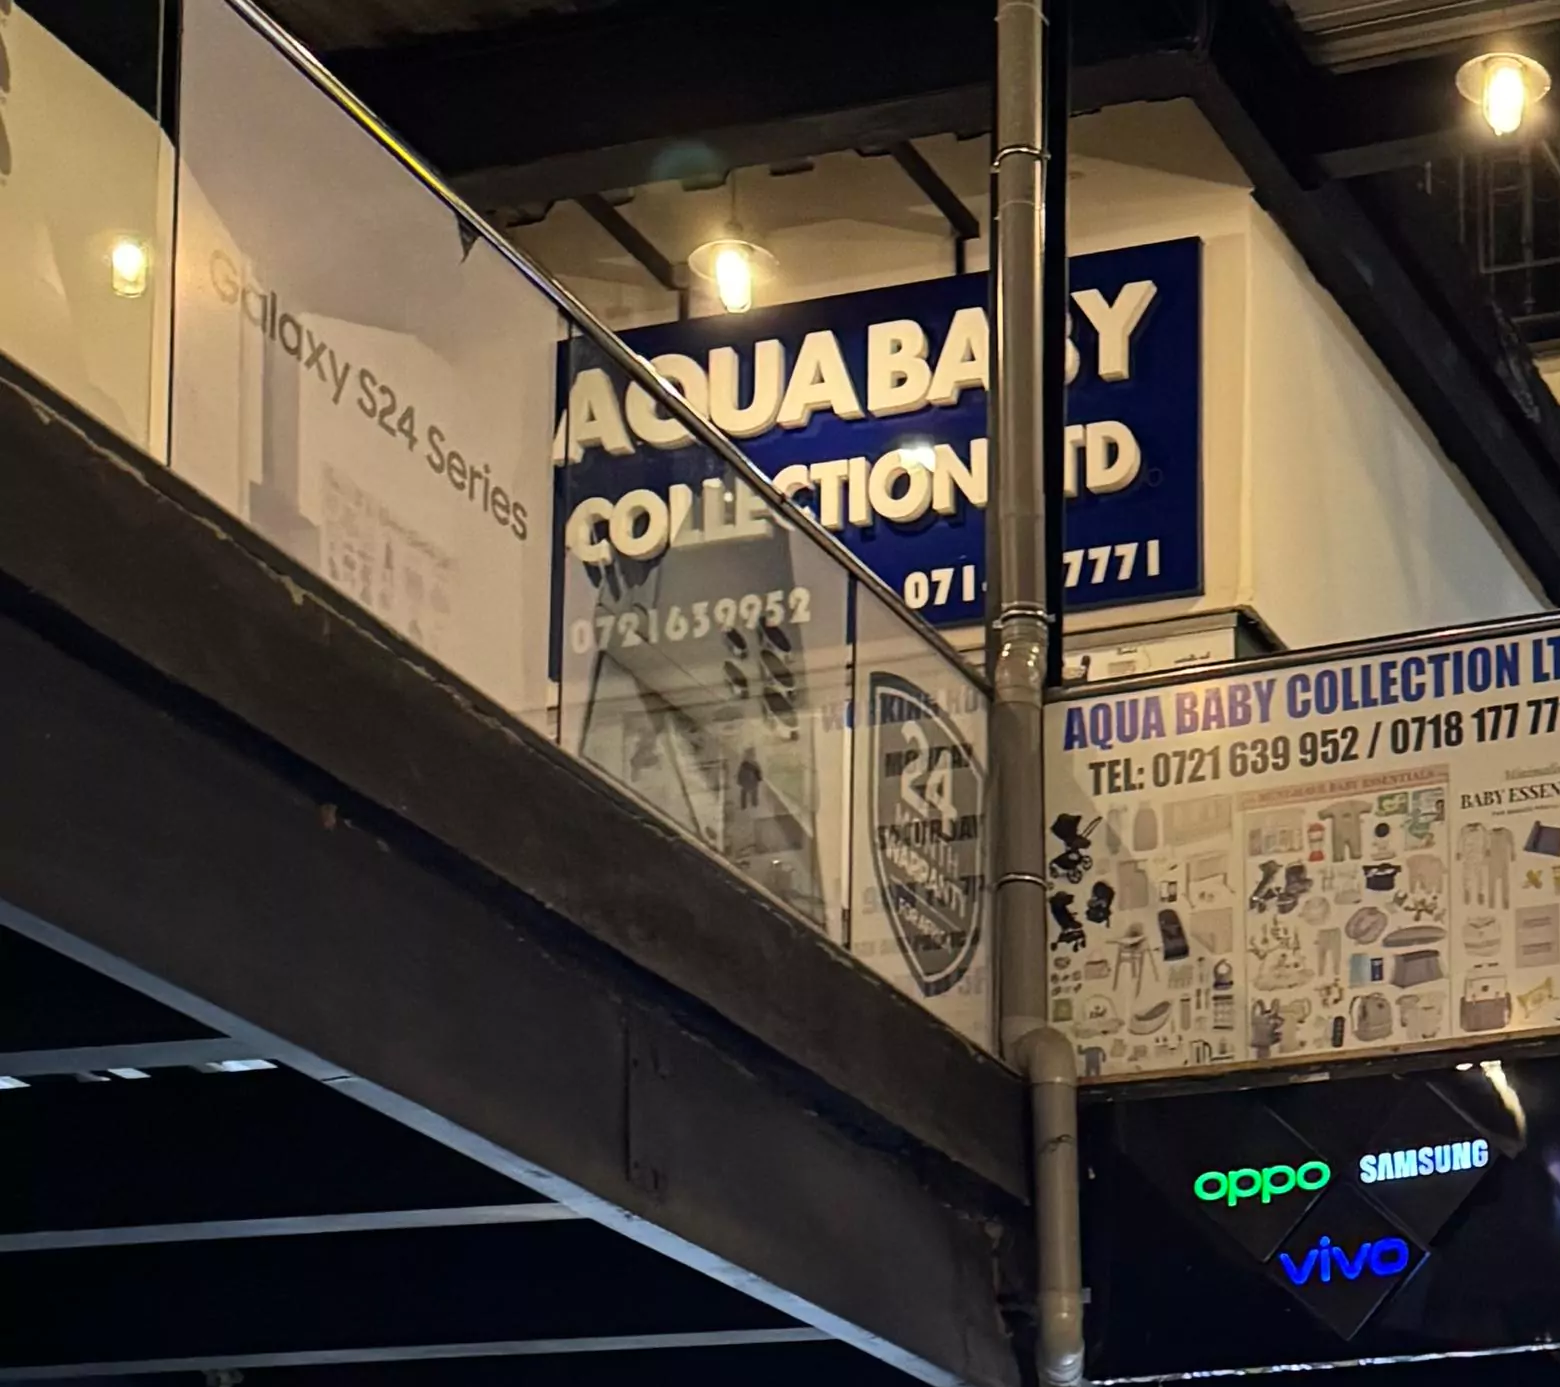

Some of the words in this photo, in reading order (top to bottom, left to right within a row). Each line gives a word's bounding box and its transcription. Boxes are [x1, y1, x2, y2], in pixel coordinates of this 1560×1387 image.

[209, 252, 351, 406] Galaxy
[357, 368, 418, 452] S24
[426, 425, 528, 541] Series
[552, 328, 864, 467] AQUA
[866, 279, 1157, 419] BAY
[1063, 420, 1141, 497] TD
[572, 586, 811, 656] 0721639952
[1063, 692, 1179, 751] AQUA
[1175, 676, 1278, 735] BABY
[1286, 643, 1521, 719] COLLECTION
[901, 722, 959, 837] 24
[1088, 758, 1145, 797] TEL:
[1151, 745, 1224, 789] 0721
[1228, 735, 1291, 778] 639
[1299, 724, 1360, 768] 952
[1367, 721, 1381, 760] /
[1390, 709, 1463, 755] 0718
[1469, 702, 1521, 741] 177
[1459, 788, 1506, 810] BABY
[1193, 1159, 1332, 1207] oppo
[1358, 1138, 1490, 1185] SAMSUNG
[1278, 1235, 1410, 1286] vivo
